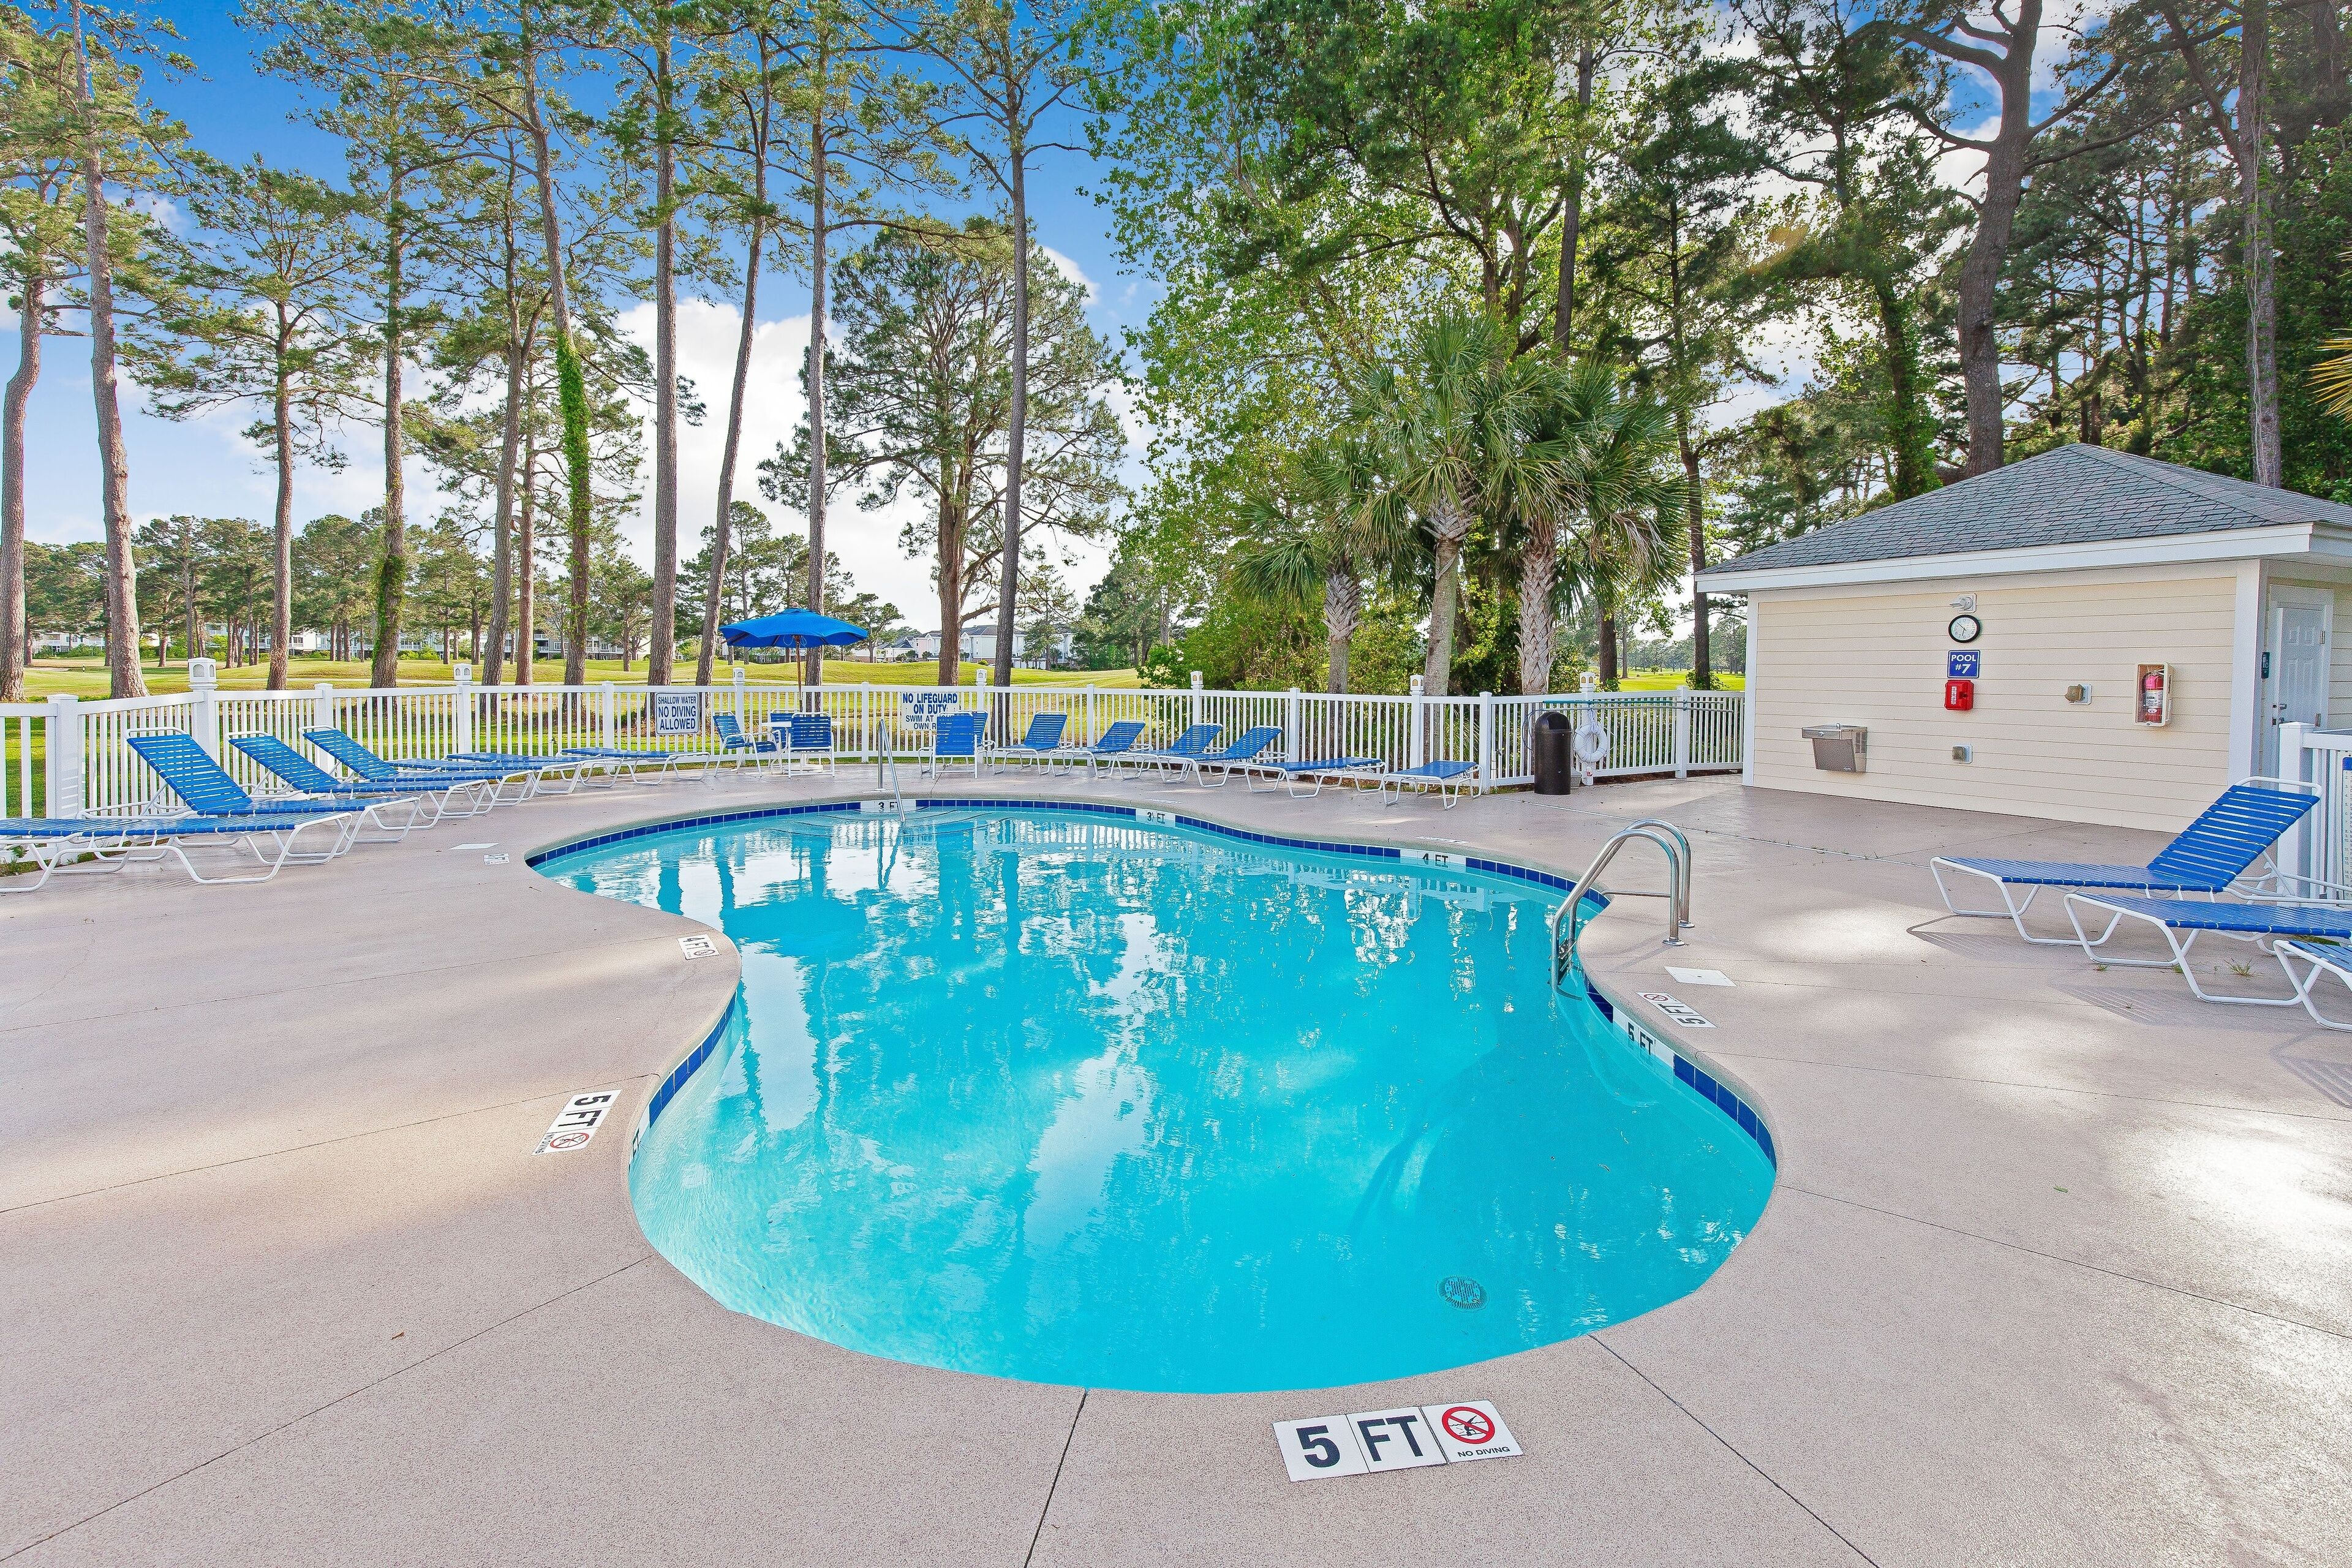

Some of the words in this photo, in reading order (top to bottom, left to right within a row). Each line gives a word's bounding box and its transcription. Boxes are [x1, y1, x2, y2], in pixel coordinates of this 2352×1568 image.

[1955, 663, 1972, 674] #7
[903, 693, 913, 703] NO
[917, 693, 958, 703] LIFEGUARD
[658, 706, 669, 717] NO
[672, 706, 696, 717] DIVING
[913, 704, 924, 714] ON
[927, 704, 947, 714] DUTY
[660, 718, 696, 730] ALLOWED
[1657, 1003, 1694, 1014] FT
[1627, 1022, 1635, 1042] 5
[1640, 1031, 1654, 1055] FT
[574, 1095, 612, 1106] 5
[557, 1110, 602, 1127] FT
[1295, 1425, 1340, 1468] 5
[1357, 1415, 1423, 1462] FT
[1476, 1446, 1511, 1455] DIVING
